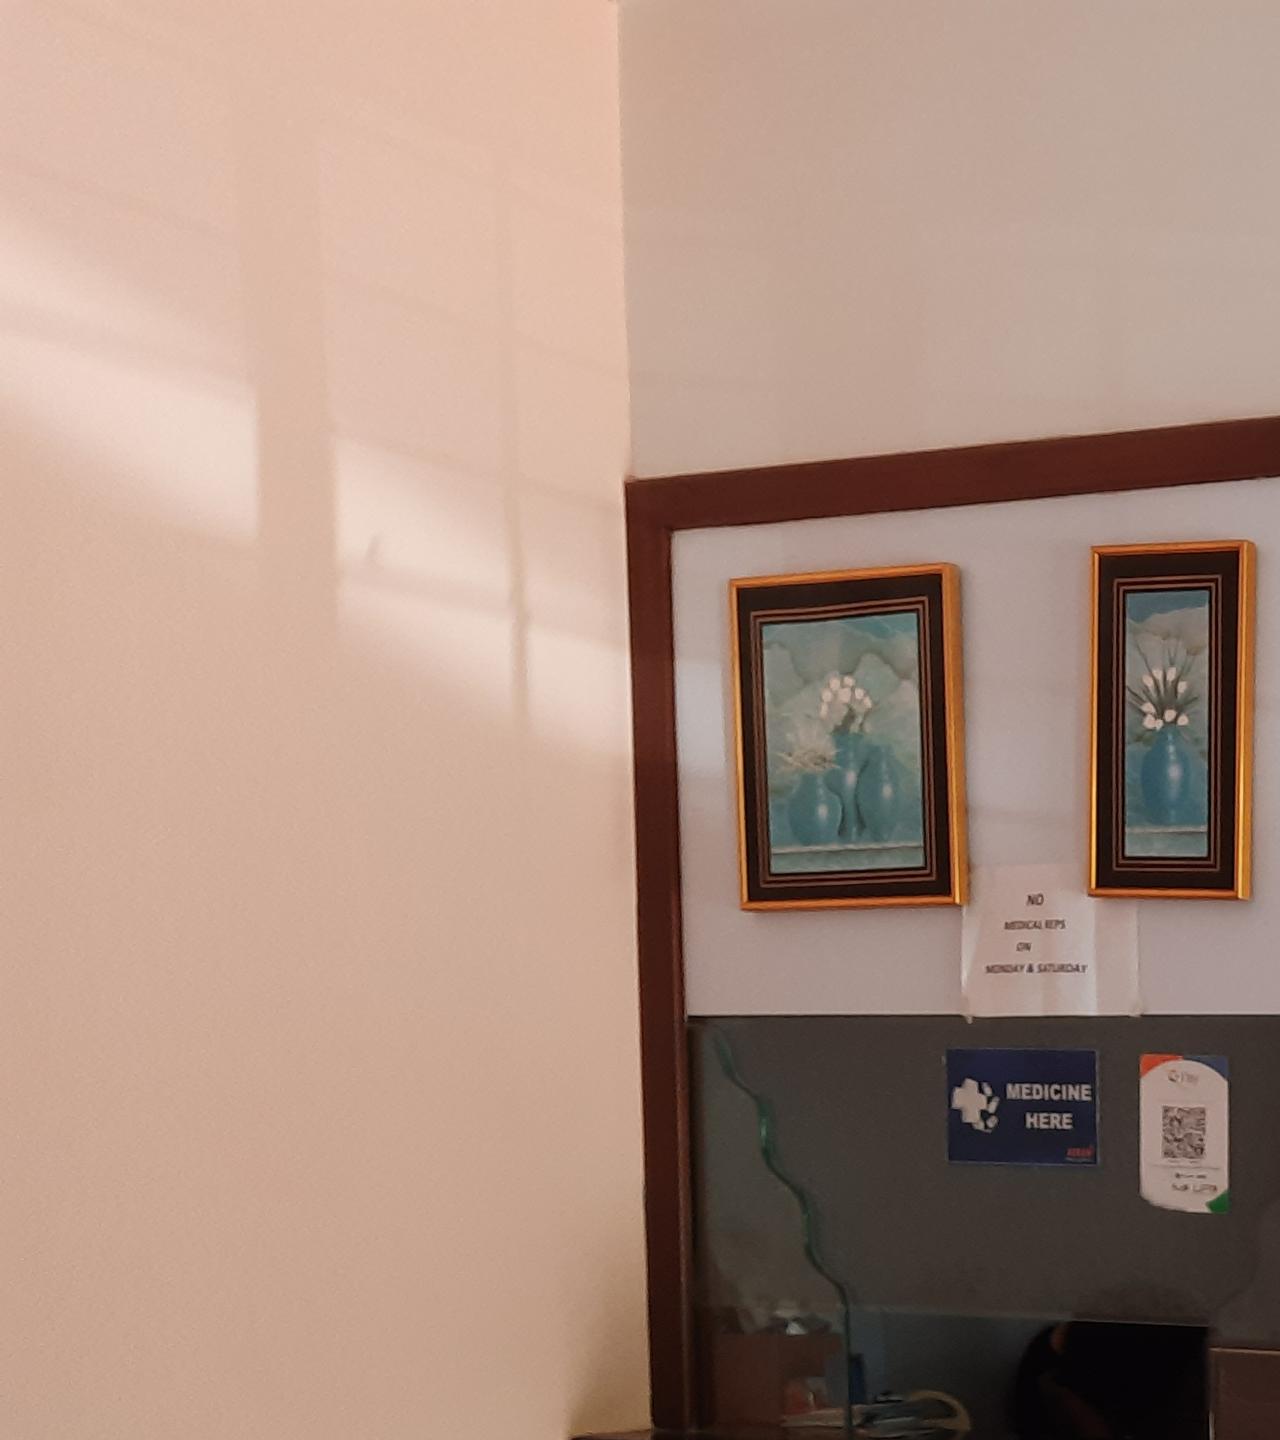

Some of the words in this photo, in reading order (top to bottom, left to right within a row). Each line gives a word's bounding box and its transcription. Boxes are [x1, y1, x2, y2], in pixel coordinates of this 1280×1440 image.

[1026, 893, 1044, 907] NO
[1005, 1083, 1092, 1102] MEDICINE
[1025, 1112, 1073, 1130] HERE
